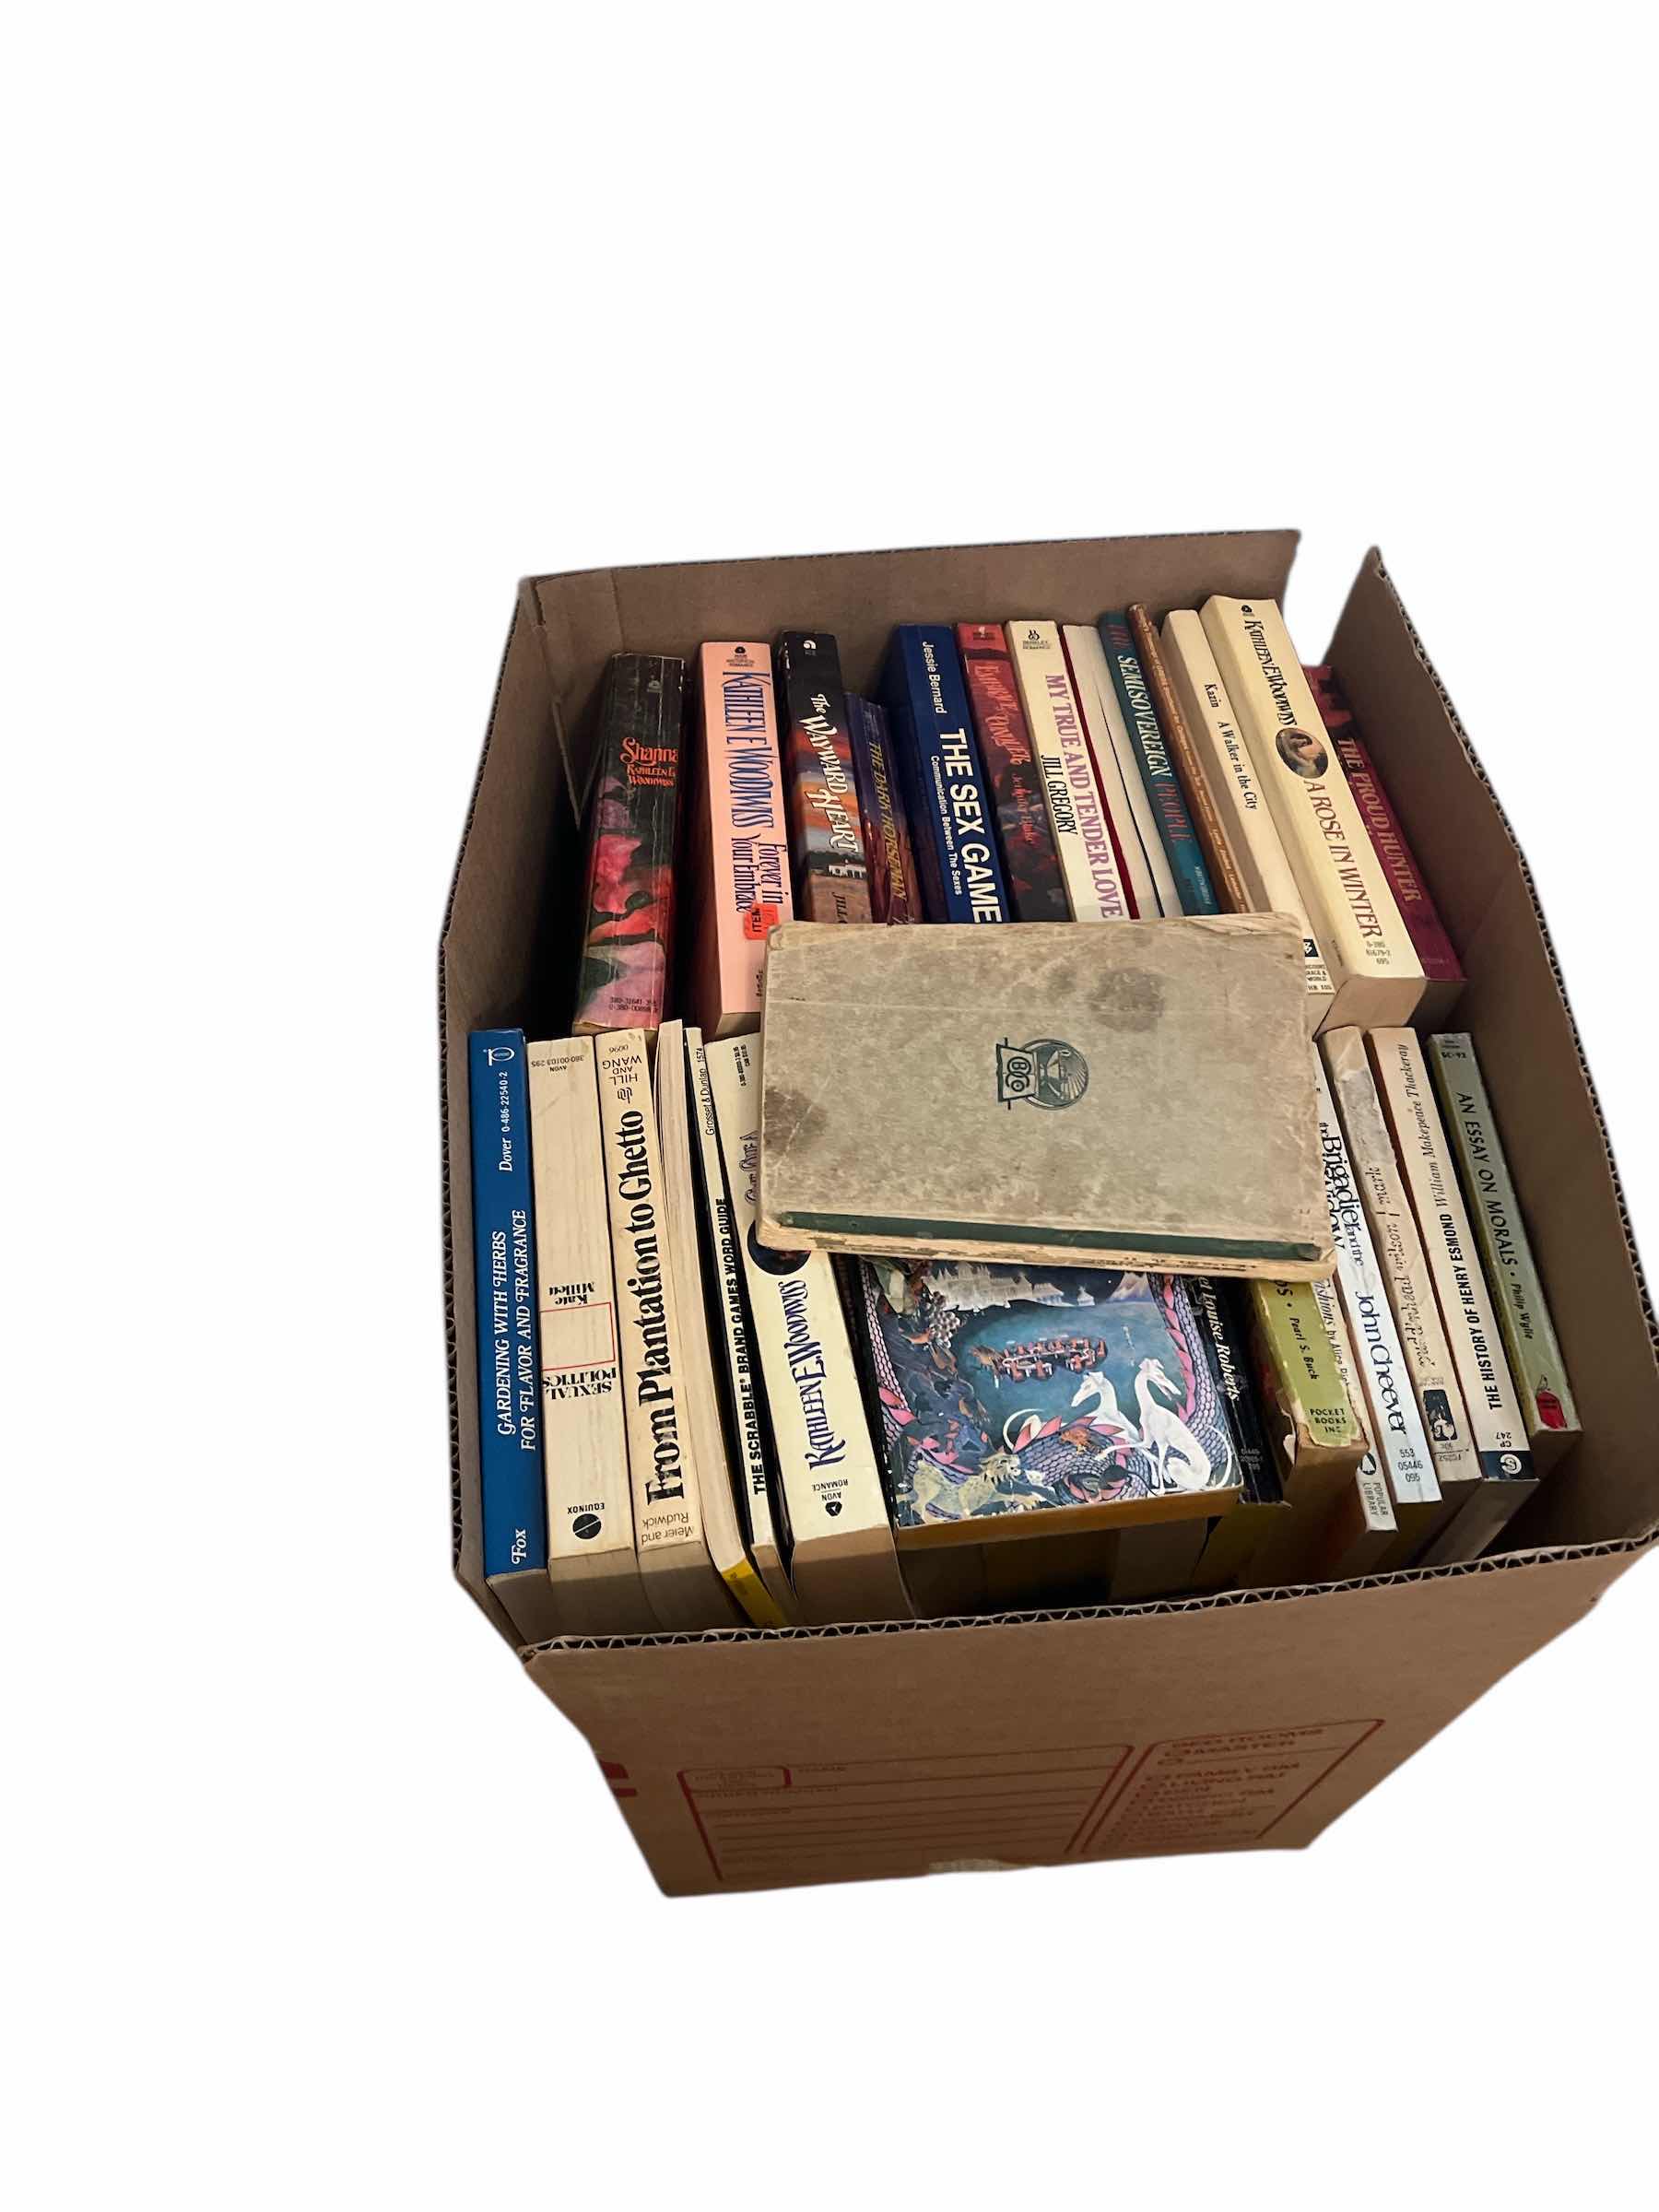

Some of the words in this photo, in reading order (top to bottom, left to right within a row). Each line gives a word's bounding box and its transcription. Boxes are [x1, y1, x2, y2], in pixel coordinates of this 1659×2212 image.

[923, 641, 936, 672] Jessie
[722, 671, 771, 733] KATHLEEN
[811, 694, 830, 713] The
[928, 674, 947, 714] Bernard
[1045, 674, 1067, 702] MY
[1053, 703, 1081, 748] TRUE
[1117, 655, 1172, 778] SEMISOVEREIGN
[1218, 721, 1230, 729] A
[619, 737, 678, 766] Shanna
[799, 715, 848, 794] WAYWARD
[939, 728, 973, 777] THE
[1222, 730, 1239, 762] Walker
[1041, 755, 1063, 781] JILL
[1065, 753, 1090, 793] AND
[1234, 764, 1245, 773] in
[1238, 775, 1251, 789] the
[724, 747, 778, 829] WOODIWISS
[931, 756, 948, 815] Communication
[1244, 792, 1258, 810] City
[1303, 780, 1324, 793] A
[805, 789, 859, 853] HEART
[949, 784, 984, 835] SEX
[1048, 782, 1078, 836] GREGORY
[1311, 793, 1345, 842] ROSE
[1337, 738, 1365, 770] THE
[1352, 771, 1389, 829] PROUD
[1377, 826, 1422, 902] HUNTER
[942, 816, 954, 852] Between
[1073, 791, 1109, 871] TENDER
[731, 833, 761, 865] Your
[881, 811, 907, 900] HORSEMAN
[947, 853, 959, 869] The
[1330, 845, 1355, 863] IN
[758, 843, 786, 892] Forever
[952, 870, 961, 896] Sexes
[961, 844, 1002, 924] GAME
[733, 865, 760, 913] Embrace
[762, 892, 789, 904] in
[1094, 869, 1124, 919] LOVE
[1338, 866, 1382, 938] WINTER
[549, 1065, 568, 1073] AVON
[601, 1054, 642, 1069] WANG
[612, 1066, 633, 1075] AND
[1398, 1044, 1418, 1098] Thackeray
[608, 1073, 638, 1086] HILL
[699, 1066, 711, 1096] Dunlap
[703, 1102, 715, 1135] Grosset
[1456, 1091, 1477, 1113] AN
[1415, 1100, 1436, 1158] Makepeace
[1465, 1121, 1490, 1163] ESSAY
[499, 1137, 513, 1172] Dover
[616, 1110, 652, 1201] Ghetto
[1323, 1135, 1361, 1231] Brigadier
[1429, 1161, 1449, 1207] William
[1478, 1169, 1497, 1193] ON
[624, 1204, 655, 1235] to
[716, 1198, 730, 1241] GUIDE
[1487, 1200, 1518, 1265] MORALS
[1346, 1227, 1357, 1247] and
[1440, 1214, 1463, 1261] ESMOND
[492, 1230, 506, 1288] HERBS
[512, 1209, 529, 1304] FRAGRANCE
[724, 1241, 736, 1277] WORD
[1351, 1245, 1364, 1266] the
[555, 1294, 588, 1306] Kate
[1453, 1265, 1475, 1305] HENRY
[493, 1295, 508, 1338] WITH
[627, 1233, 674, 1406] Plantation
[726, 1277, 743, 1328] GAMES
[1465, 1308, 1480, 1324] OF
[516, 1306, 532, 1339] AND
[778, 1280, 824, 1361] WOODIWISS
[1290, 1317, 1306, 1340] Pearl
[733, 1329, 749, 1375] BRAND
[1203, 1293, 1223, 1340] Louise
[1216, 1342, 1241, 1402] Roberts
[1300, 1345, 1310, 1353] S.
[1356, 1291, 1382, 1346] John
[1370, 1345, 1407, 1435] Cheever
[1469, 1327, 1495, 1381] HISTORY
[517, 1344, 535, 1412] FLAVOR
[542, 1367, 617, 1386] POLITICS
[1304, 1357, 1320, 1380] Buck
[494, 1340, 516, 1435] GARDENING
[546, 1381, 612, 1400] SEXUAL
[1484, 1385, 1502, 1410] THE
[805, 1382, 846, 1471] KATHLEEN
[1310, 1408, 1346, 1418] POCKET
[1314, 1417, 1347, 1425] BOOKS
[522, 1416, 536, 1451] FOR
[1496, 1431, 1512, 1440] 247
[1500, 1440, 1512, 1448] CP
[645, 1405, 685, 1506] From
[1398, 1460, 1423, 1471] 05446
[1400, 1448, 1415, 1458] 553
[754, 1465, 767, 1495] THE
[812, 1478, 849, 1491] ROMANCE
[1406, 1473, 1421, 1483] 095
[567, 1502, 605, 1514] EQUINOX
[821, 1492, 841, 1501] AVON
[1373, 1482, 1389, 1516] POPULAR
[641, 1530, 661, 1546] and
[642, 1512, 689, 1530] Rudwick
[662, 1526, 694, 1540] Meier
[512, 1529, 526, 1564] Fox
